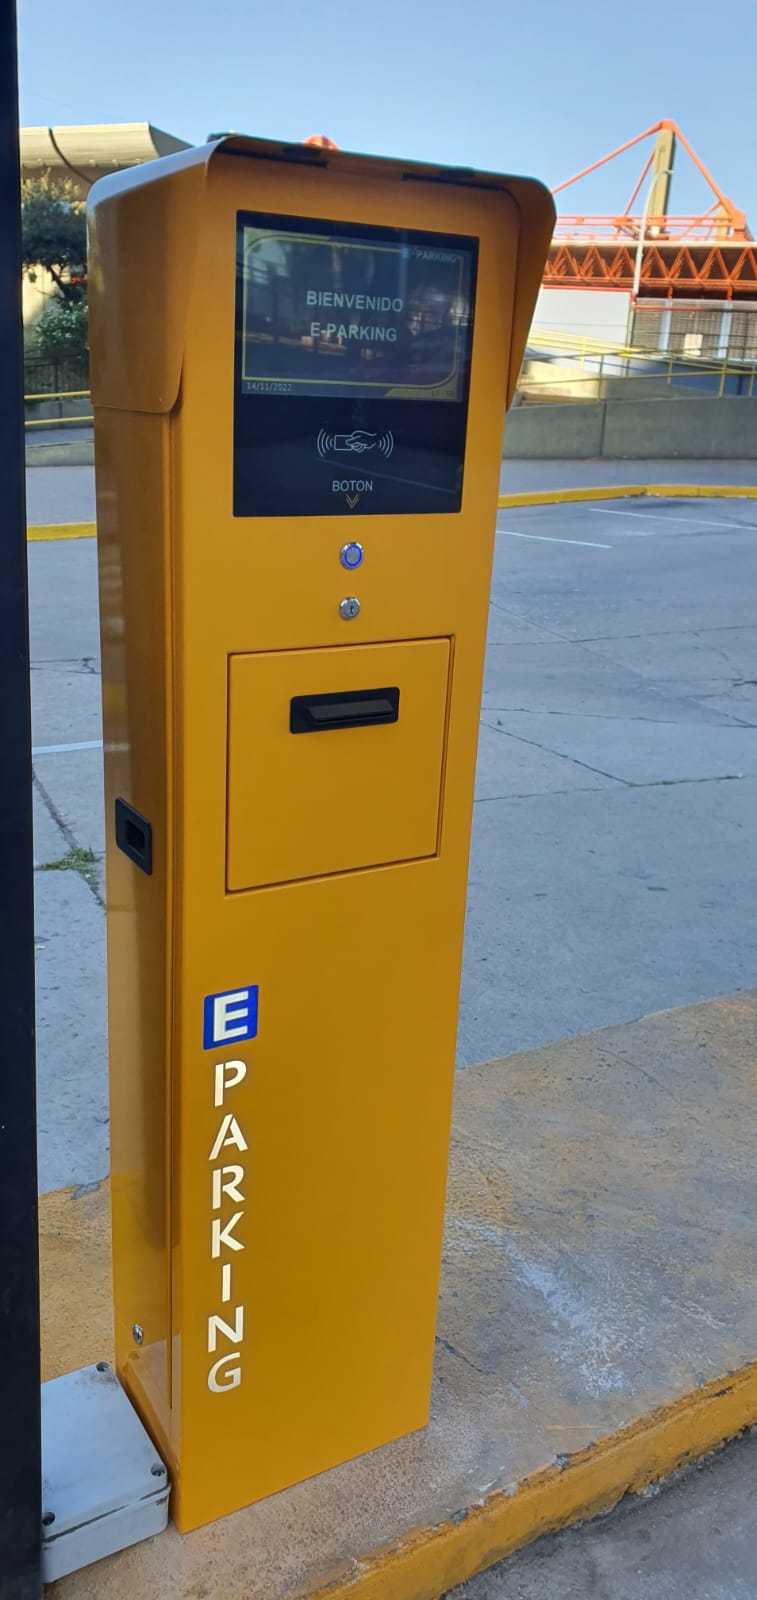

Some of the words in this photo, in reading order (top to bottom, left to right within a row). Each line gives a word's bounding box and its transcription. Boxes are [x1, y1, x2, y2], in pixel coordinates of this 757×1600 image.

[306, 290, 404, 313] BIENVENIDO
[310, 322, 398, 342] E-PARKING
[247, 382, 293, 393] 14/11/2022
[332, 480, 373, 492] BOTON
[212, 990, 249, 1043] E
[207, 1059, 249, 1393] PARKING
